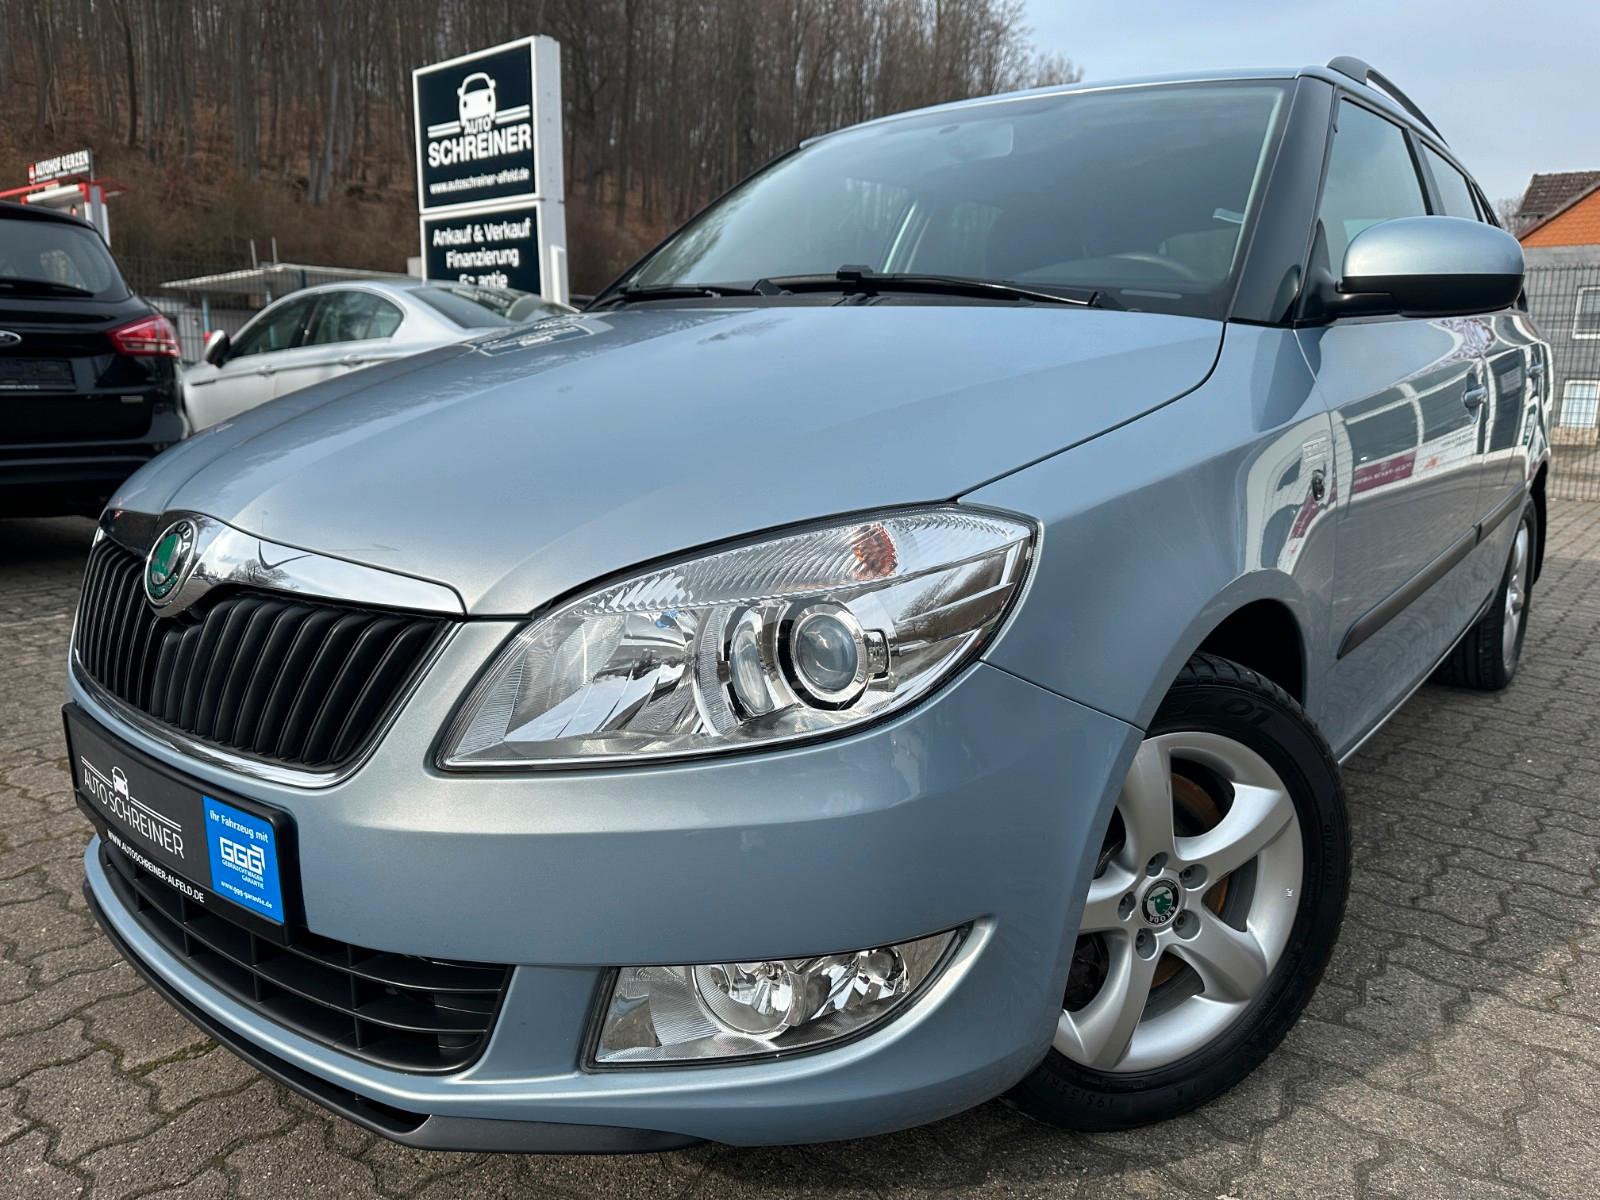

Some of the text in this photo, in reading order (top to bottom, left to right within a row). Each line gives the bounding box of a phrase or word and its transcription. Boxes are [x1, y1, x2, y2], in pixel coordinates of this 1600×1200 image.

[464, 116, 491, 135] AUTO
[428, 123, 532, 167] SCHREINER
[433, 217, 531, 246] Ankauf & Verkauf
[446, 247, 519, 268] Finanzierung
[84, 767, 185, 860] AUTO SCHREINER
[209, 809, 269, 844] Ihr Fahrzeug mit
[221, 859, 265, 883] GEBRAUCHTWAGEN
[241, 874, 265, 890] GARANTIE
[220, 880, 273, 909] www.ggg-garantie.de
